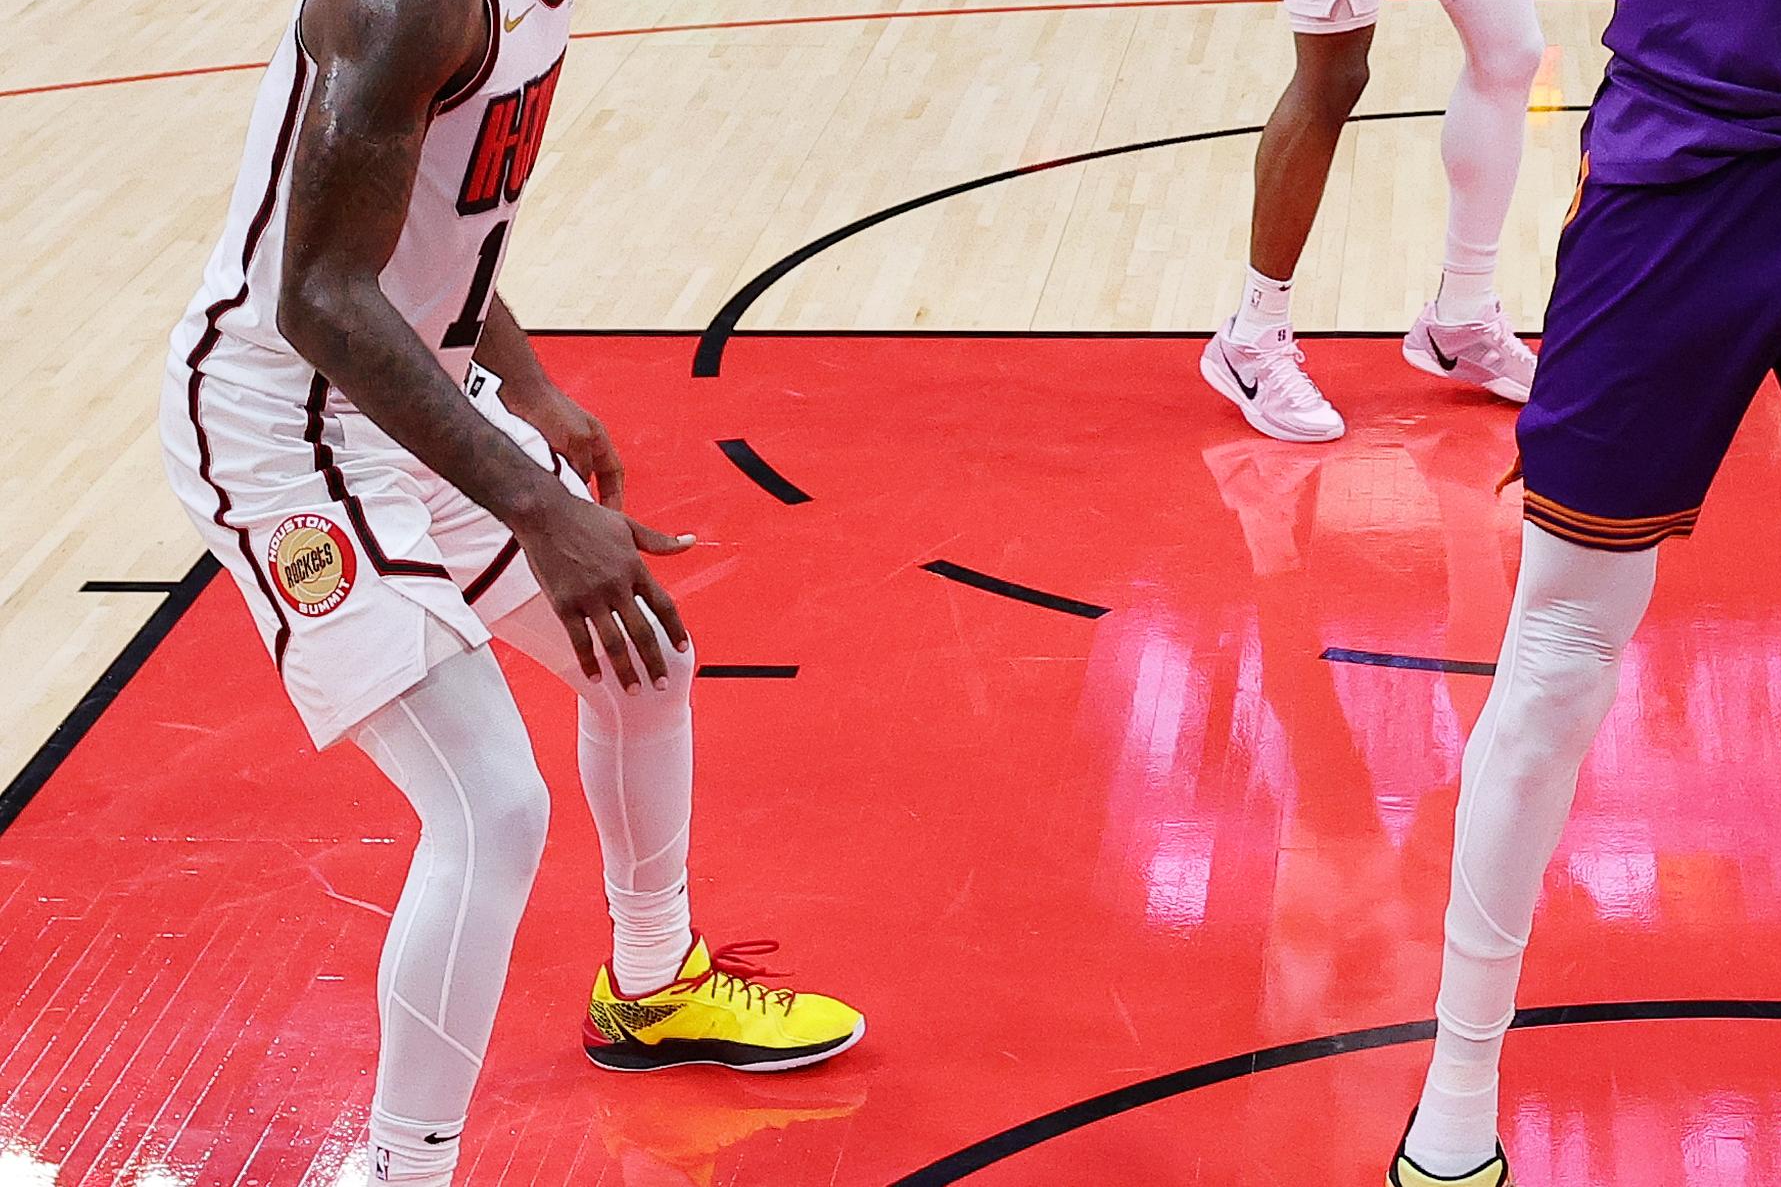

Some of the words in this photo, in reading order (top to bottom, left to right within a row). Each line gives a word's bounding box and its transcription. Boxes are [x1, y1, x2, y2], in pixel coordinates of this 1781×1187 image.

[440, 220, 509, 349] 1
[268, 516, 333, 563] HOUSTON
[298, 577, 351, 615] SUMMIT
